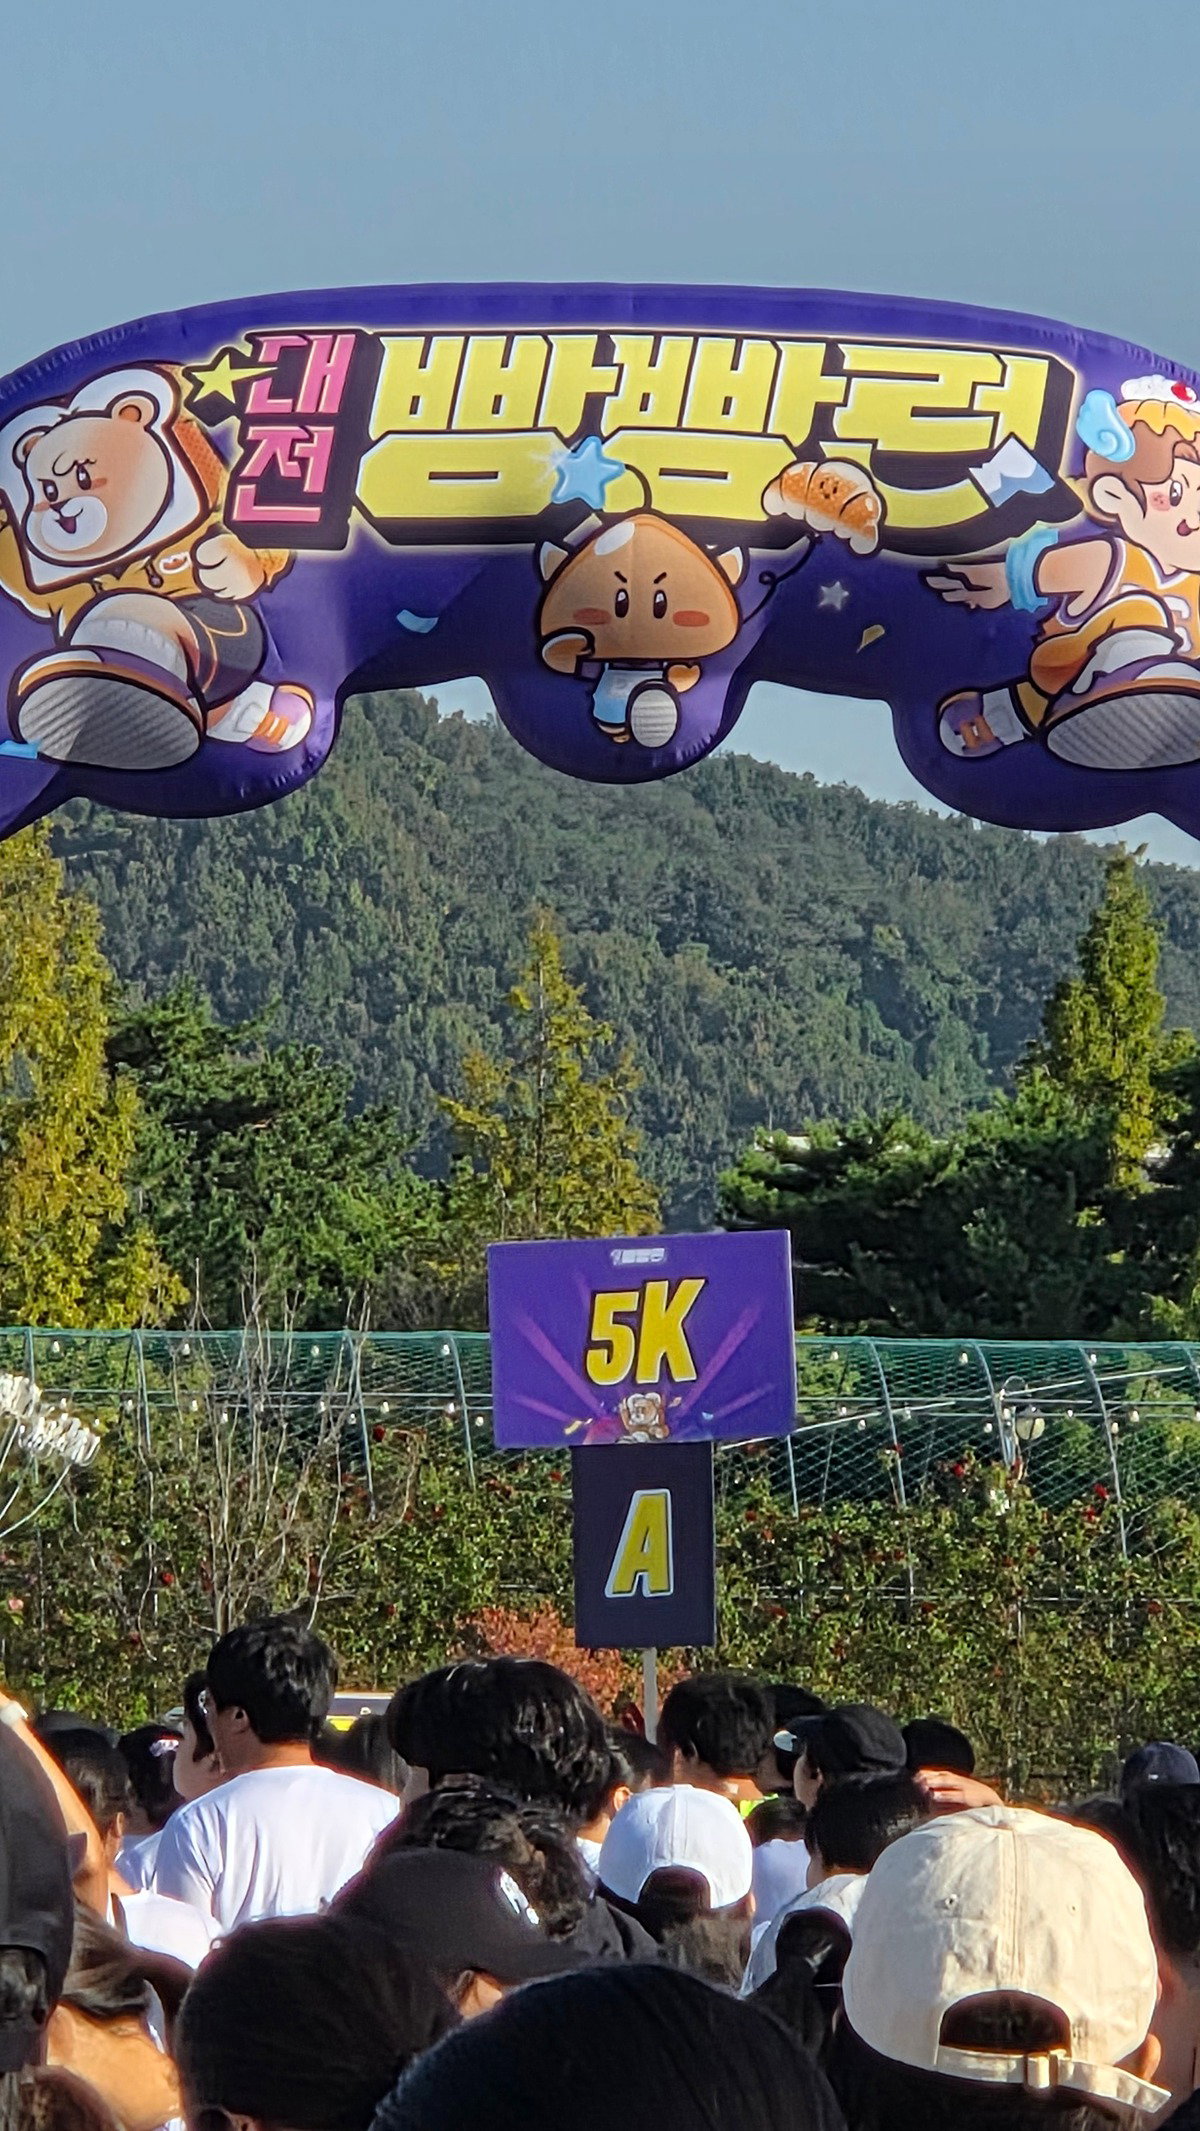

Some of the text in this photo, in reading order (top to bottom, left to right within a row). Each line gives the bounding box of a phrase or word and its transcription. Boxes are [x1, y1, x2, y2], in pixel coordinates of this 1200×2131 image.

[233, 333, 356, 522] 대전
[355, 333, 1050, 529] 빵빵런
[585, 1277, 707, 1386] 5K
[604, 1488, 675, 1599] A
